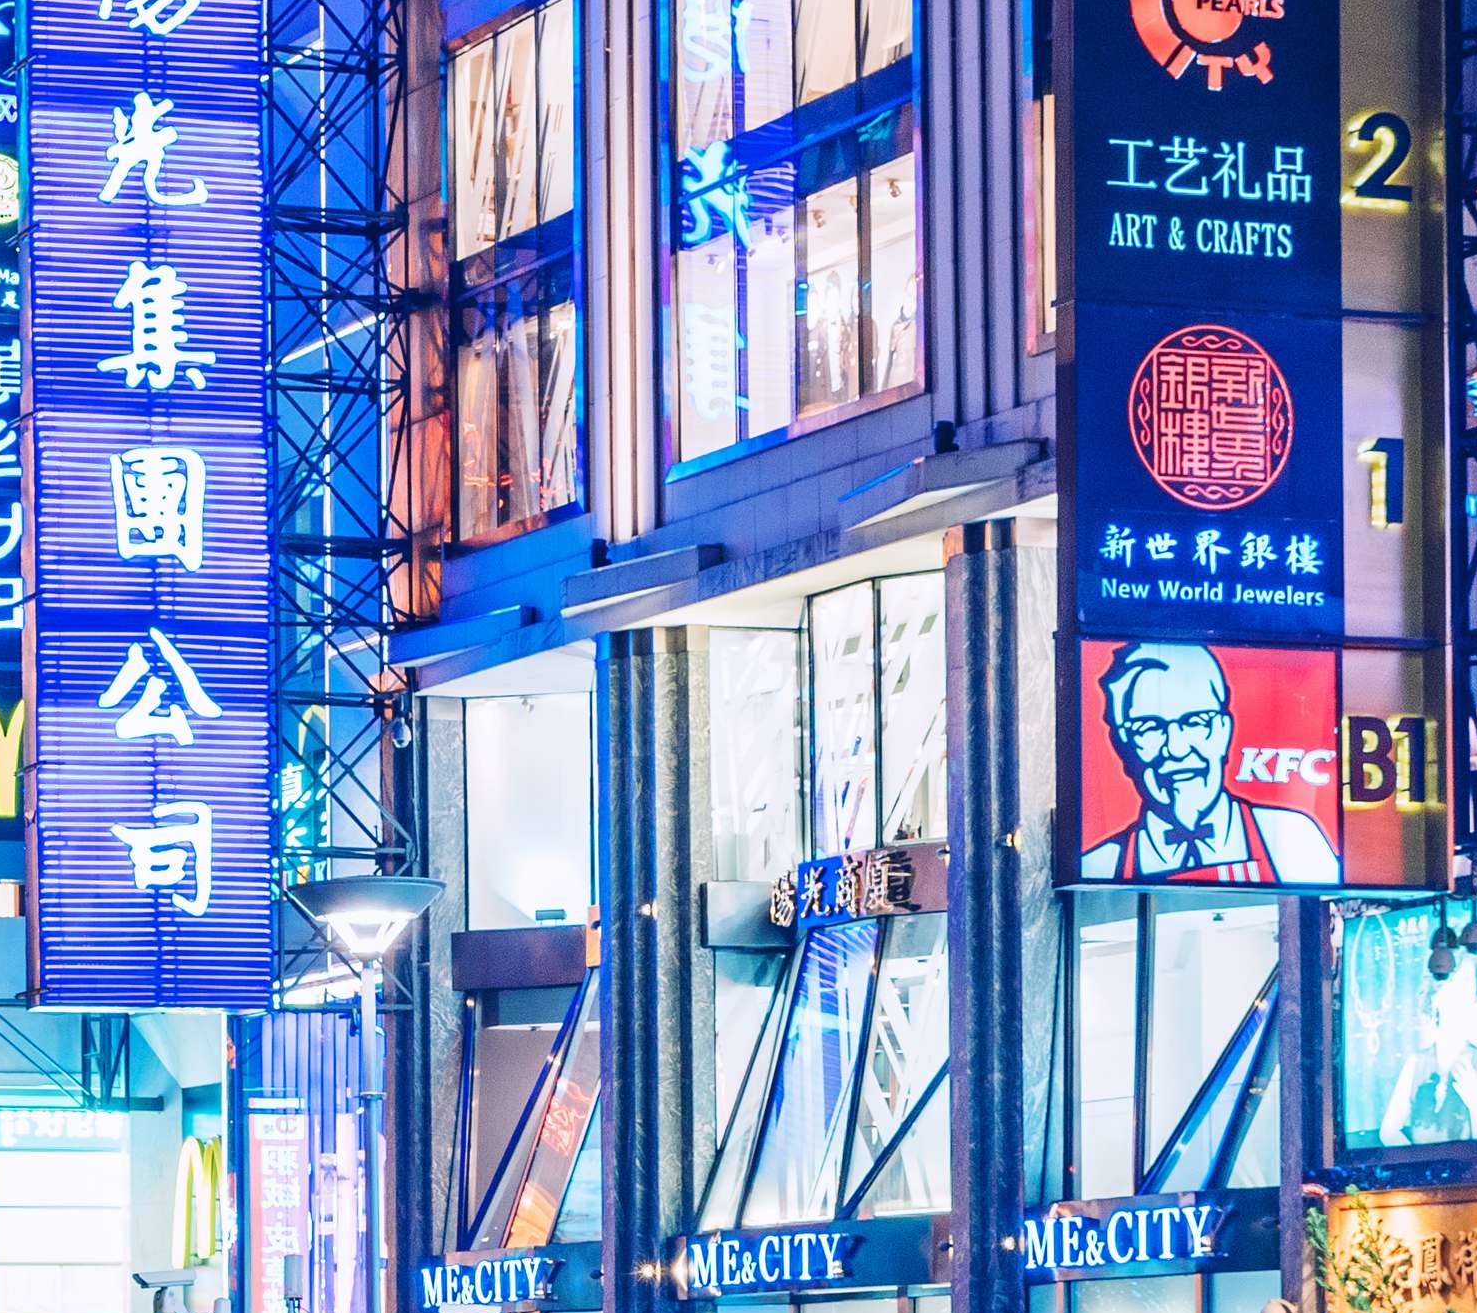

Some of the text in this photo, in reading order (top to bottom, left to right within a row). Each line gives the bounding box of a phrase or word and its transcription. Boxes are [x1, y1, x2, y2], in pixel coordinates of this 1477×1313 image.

[1106, 136, 1312, 204] 工艺礼品
[1353, 112, 1412, 202] 2
[1108, 212, 1293, 259] ART & CRAFTS
[1099, 523, 1324, 575] 新世界銀樓
[1101, 577, 1325, 608] New World Jewelers
[1235, 746, 1336, 786] KFC
[1349, 716, 1426, 804] B1
[690, 1232, 845, 1287] ME&CITY
[1024, 1204, 1212, 1270] ME&CITY
[421, 1256, 541, 1310] ME&CITY
